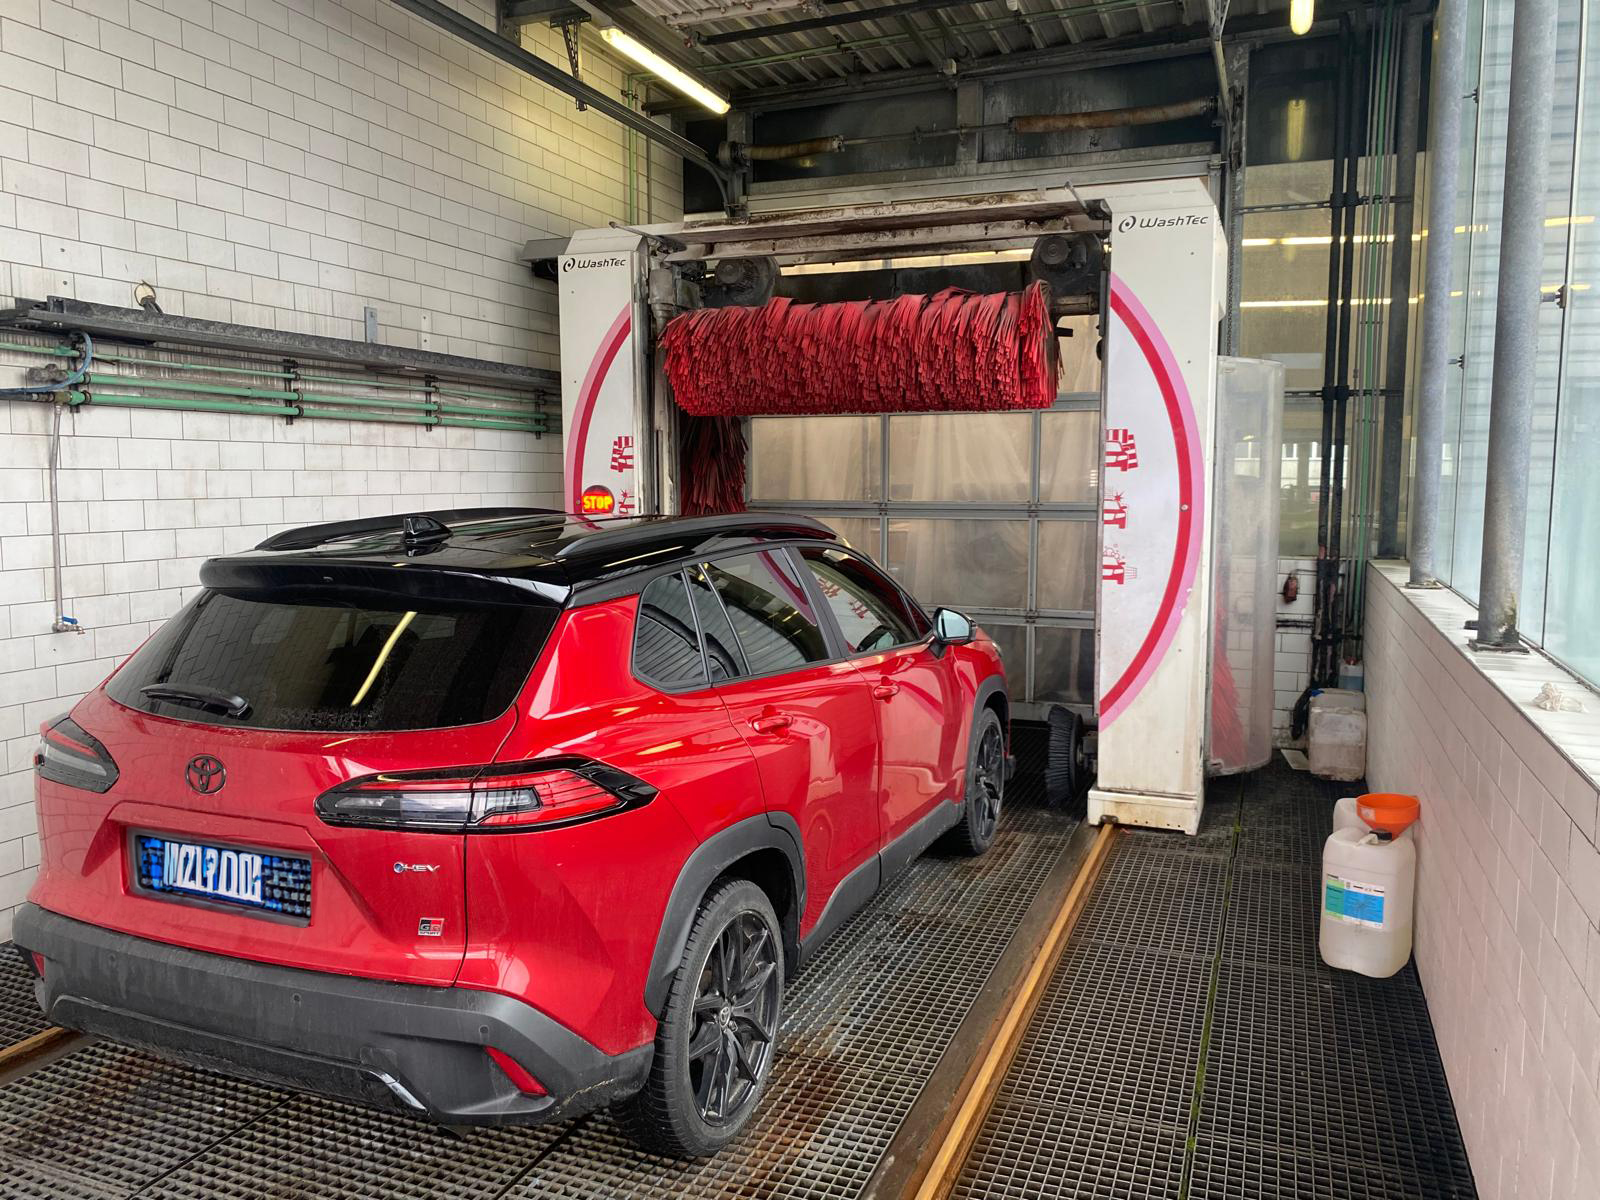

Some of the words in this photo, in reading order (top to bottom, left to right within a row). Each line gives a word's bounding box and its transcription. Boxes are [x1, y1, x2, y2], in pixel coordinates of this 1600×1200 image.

[1140, 215, 1208, 228] WashTec
[577, 258, 626, 269] WashTec
[583, 496, 613, 509] STOP
